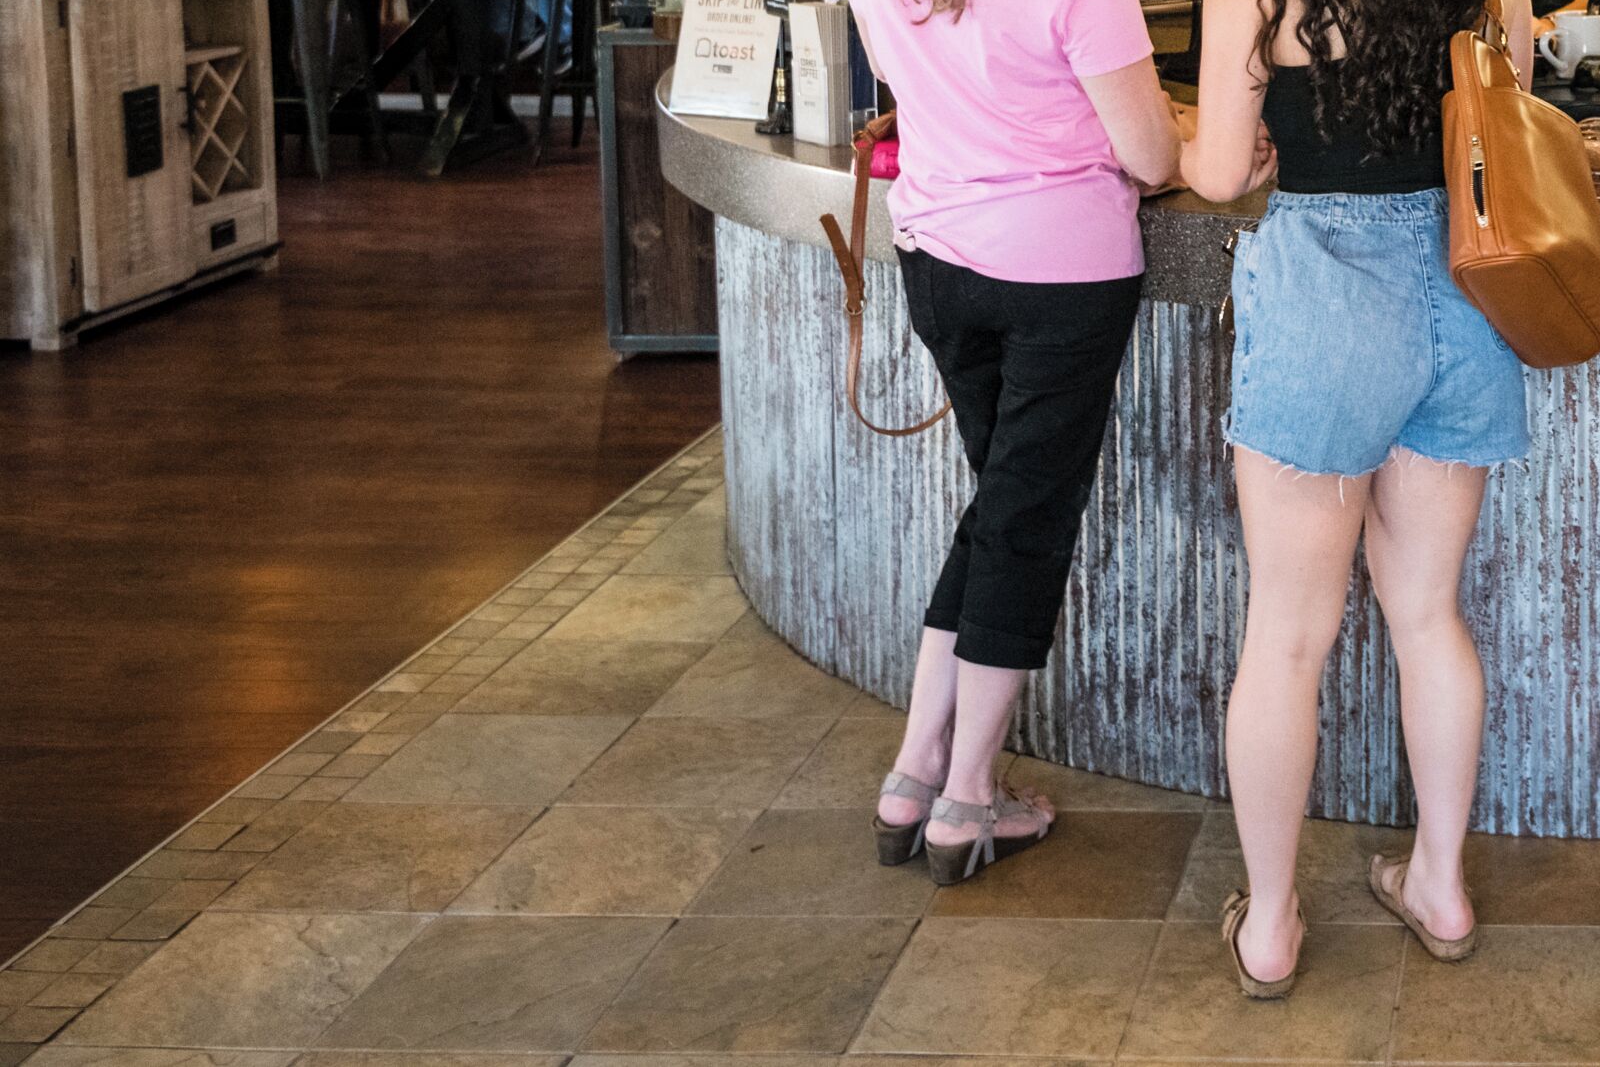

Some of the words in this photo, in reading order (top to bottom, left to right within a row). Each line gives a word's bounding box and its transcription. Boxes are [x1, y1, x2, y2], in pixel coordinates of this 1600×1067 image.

[707, 12, 729, 23] ORDER
[713, 42, 757, 61] toast
[800, 68, 819, 79] COFFEE
